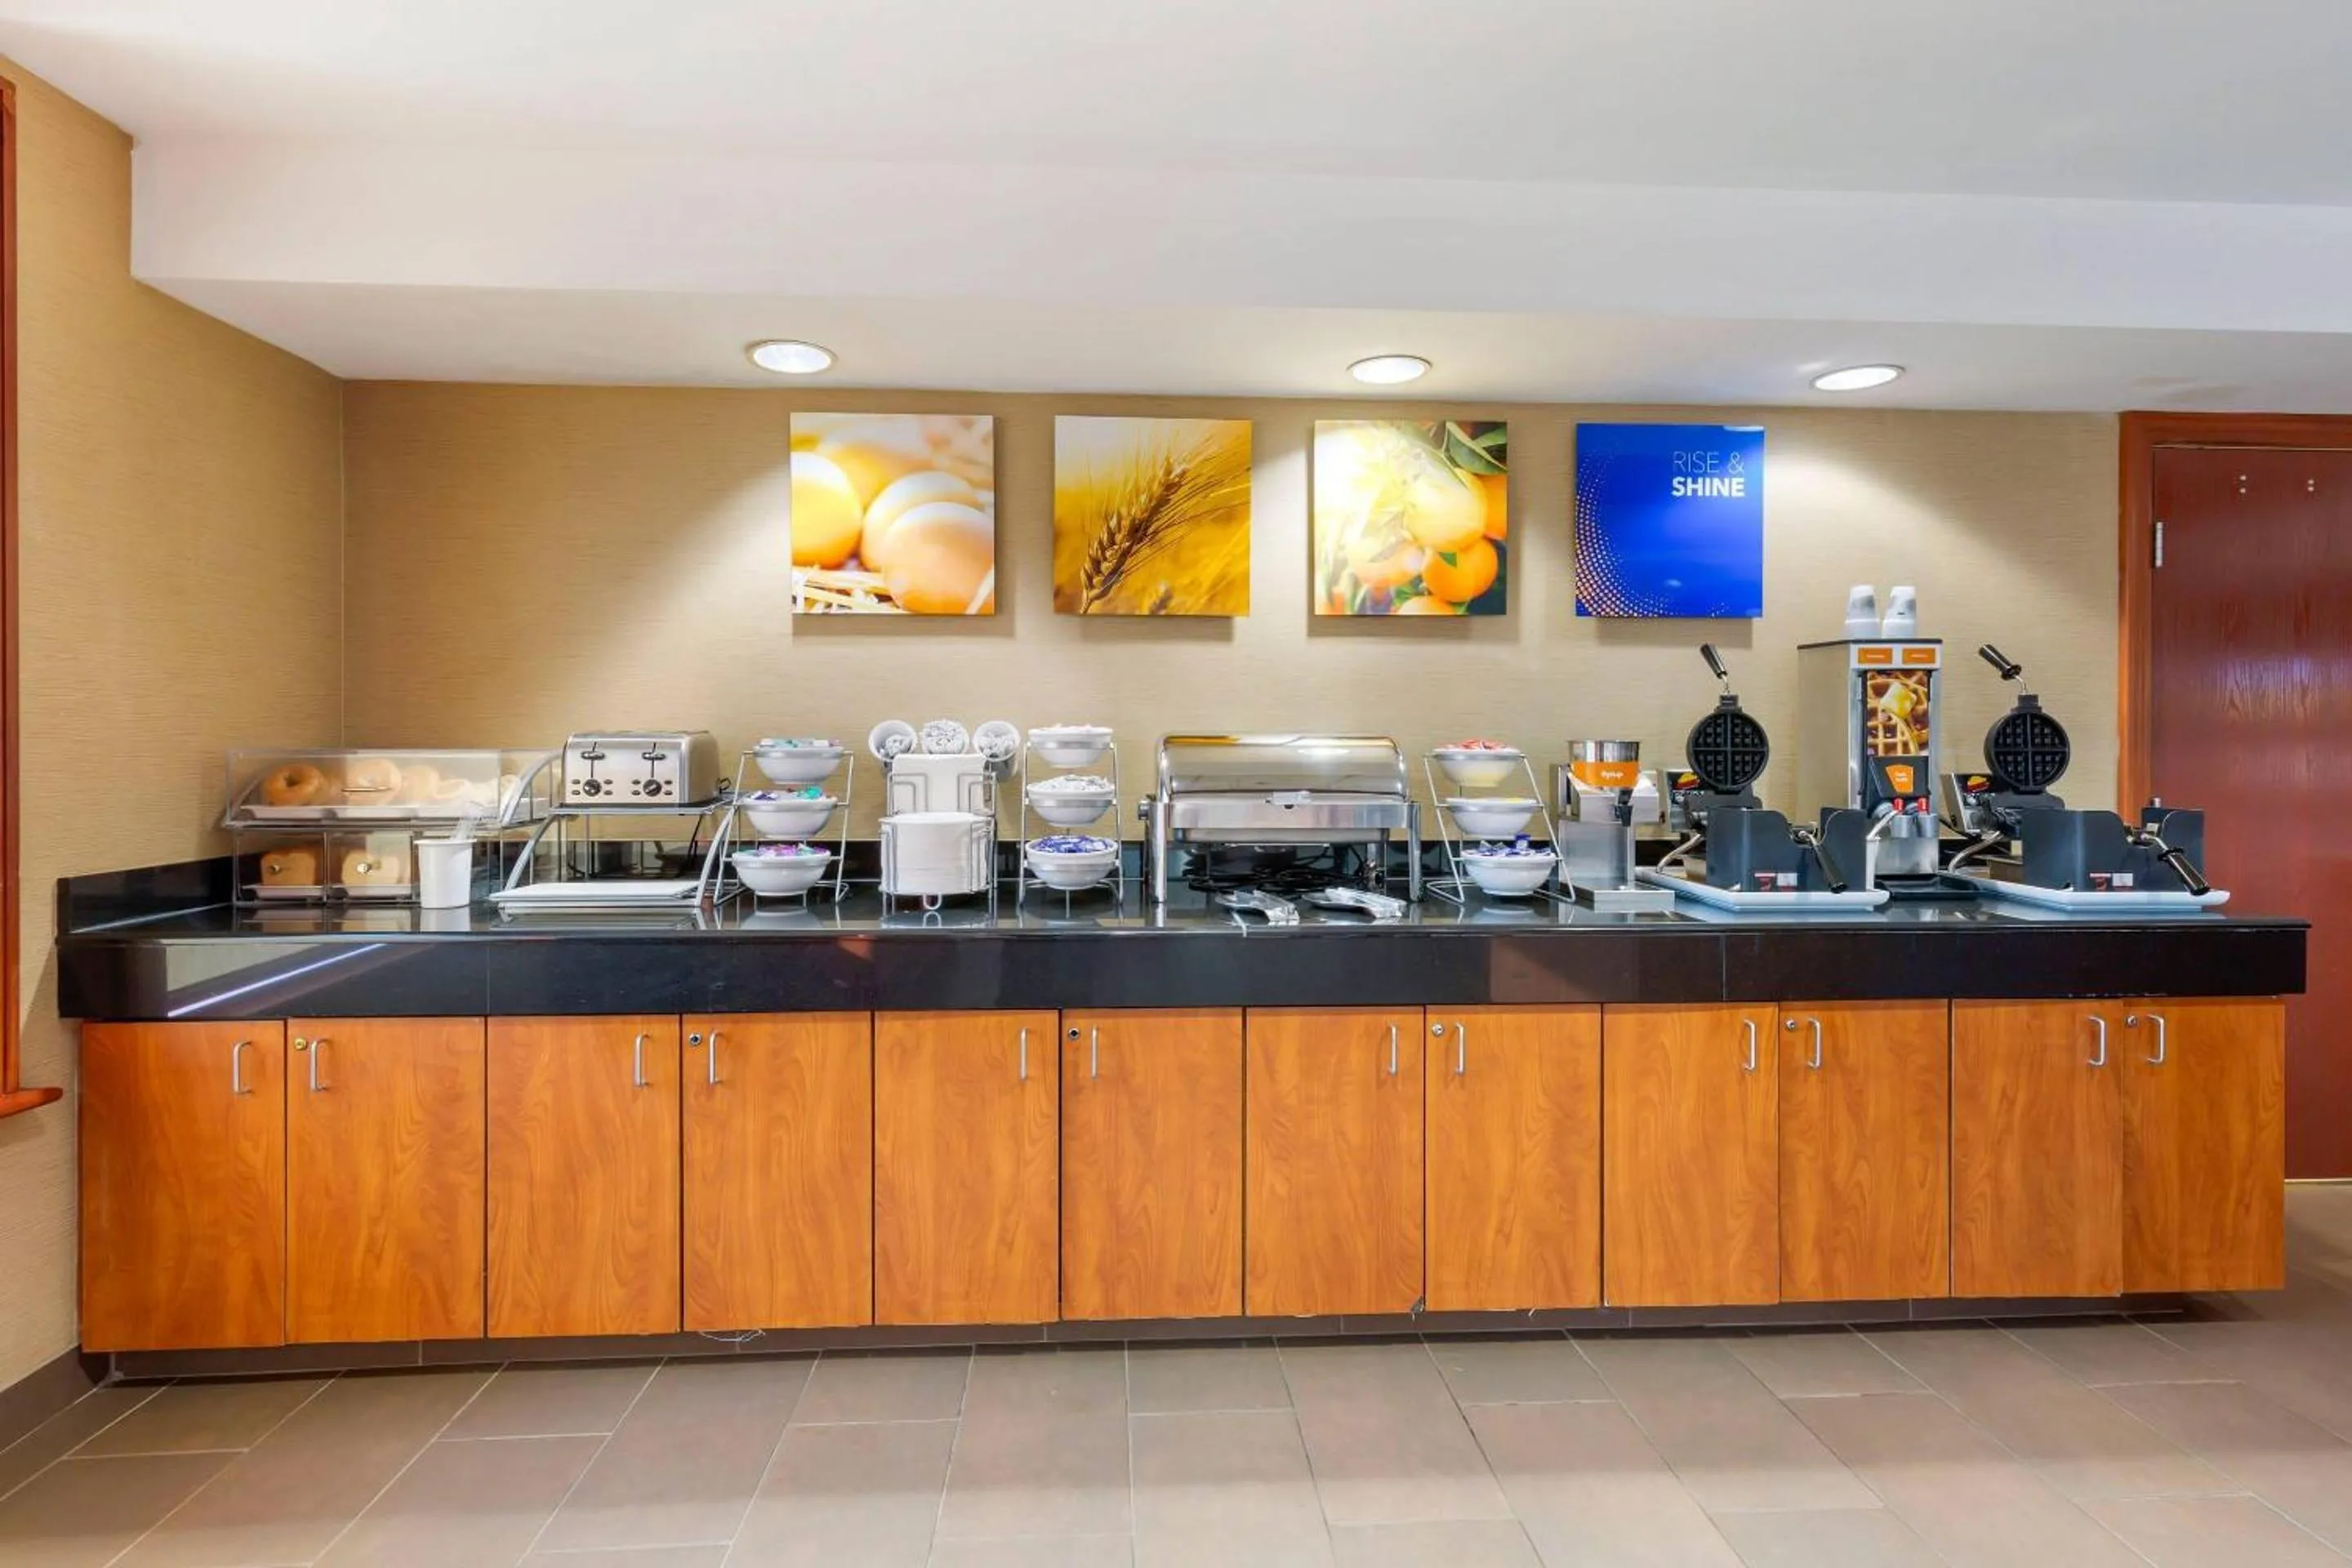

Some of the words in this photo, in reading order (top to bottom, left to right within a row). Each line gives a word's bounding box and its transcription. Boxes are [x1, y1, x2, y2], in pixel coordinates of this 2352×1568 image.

[1673, 451, 1719, 473] RISE
[1727, 451, 1744, 474] &
[1672, 476, 1745, 497] SHINE
